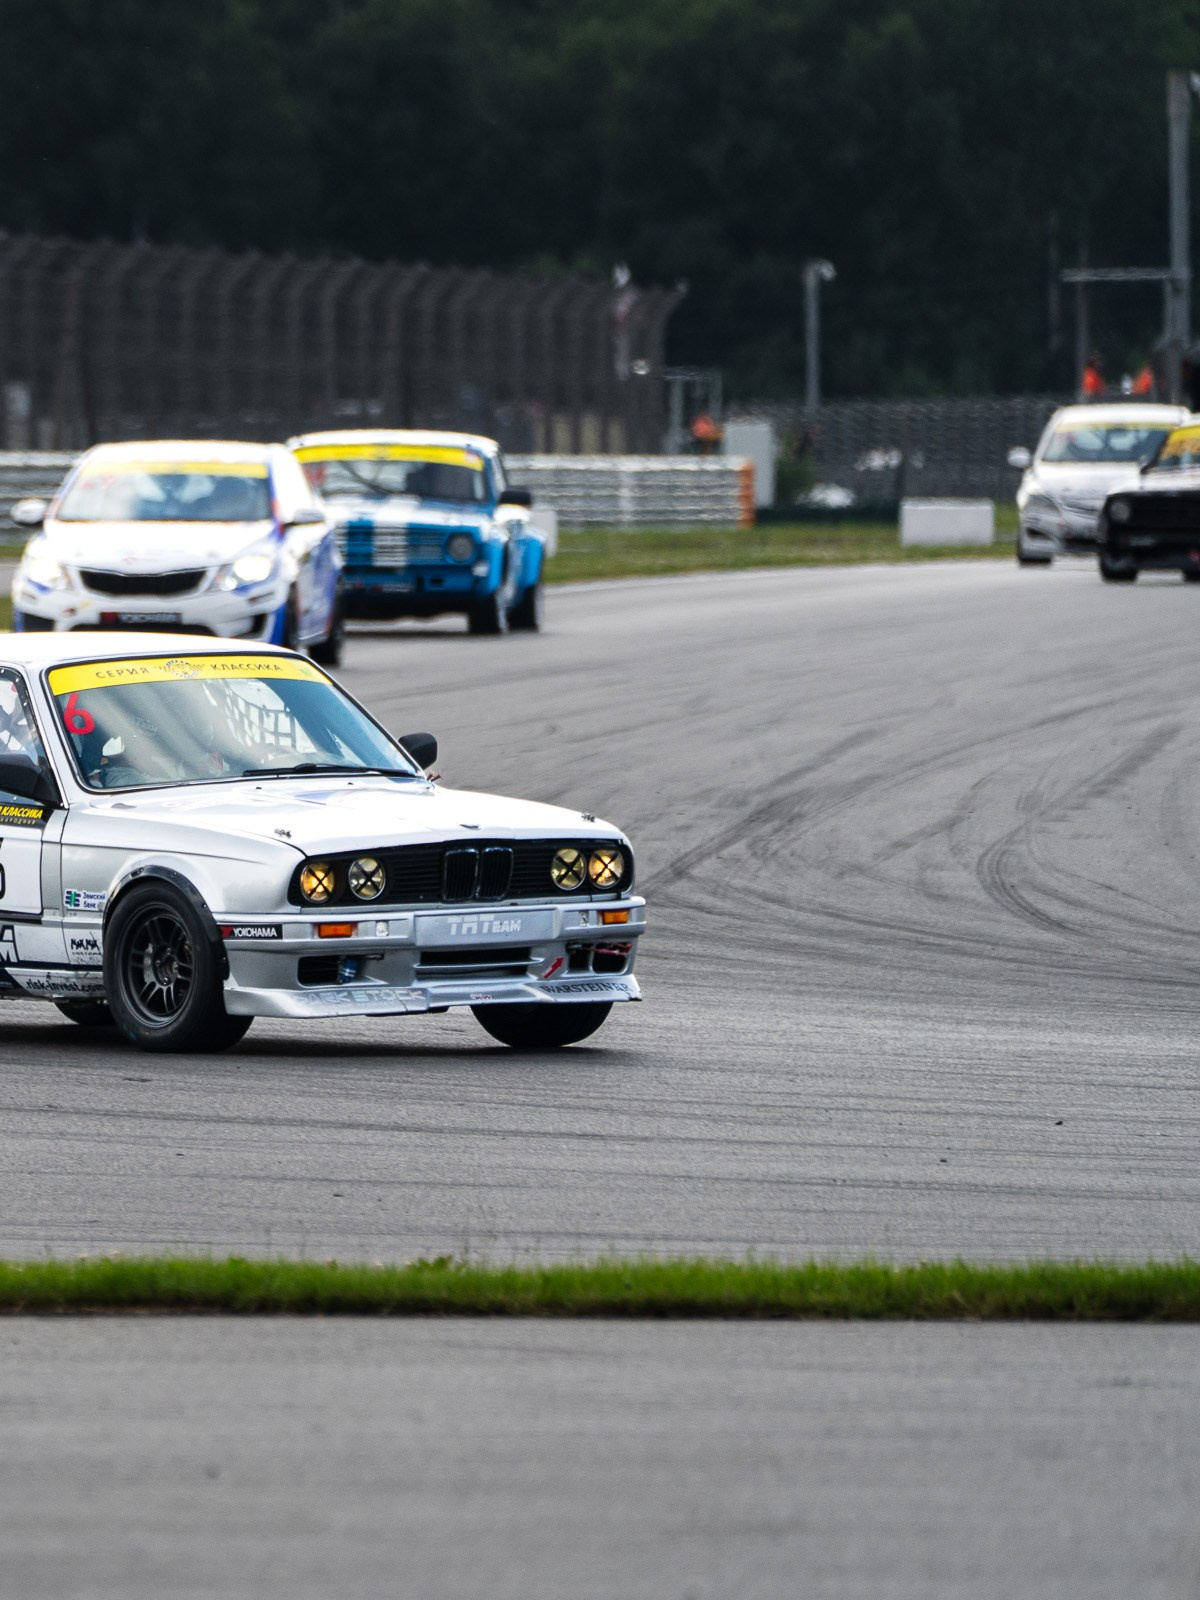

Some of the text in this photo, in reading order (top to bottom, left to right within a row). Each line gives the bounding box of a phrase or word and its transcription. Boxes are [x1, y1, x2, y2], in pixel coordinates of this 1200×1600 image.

[95, 663, 282, 679] СЕРИЯ КЛАССИКА
[63, 692, 95, 735] 6
[1, 806, 43, 819] КЛАССИКА
[83, 892, 105, 900] Земский
[233, 927, 277, 937] YOKOHAMA
[541, 982, 631, 994] WARSTEINER
